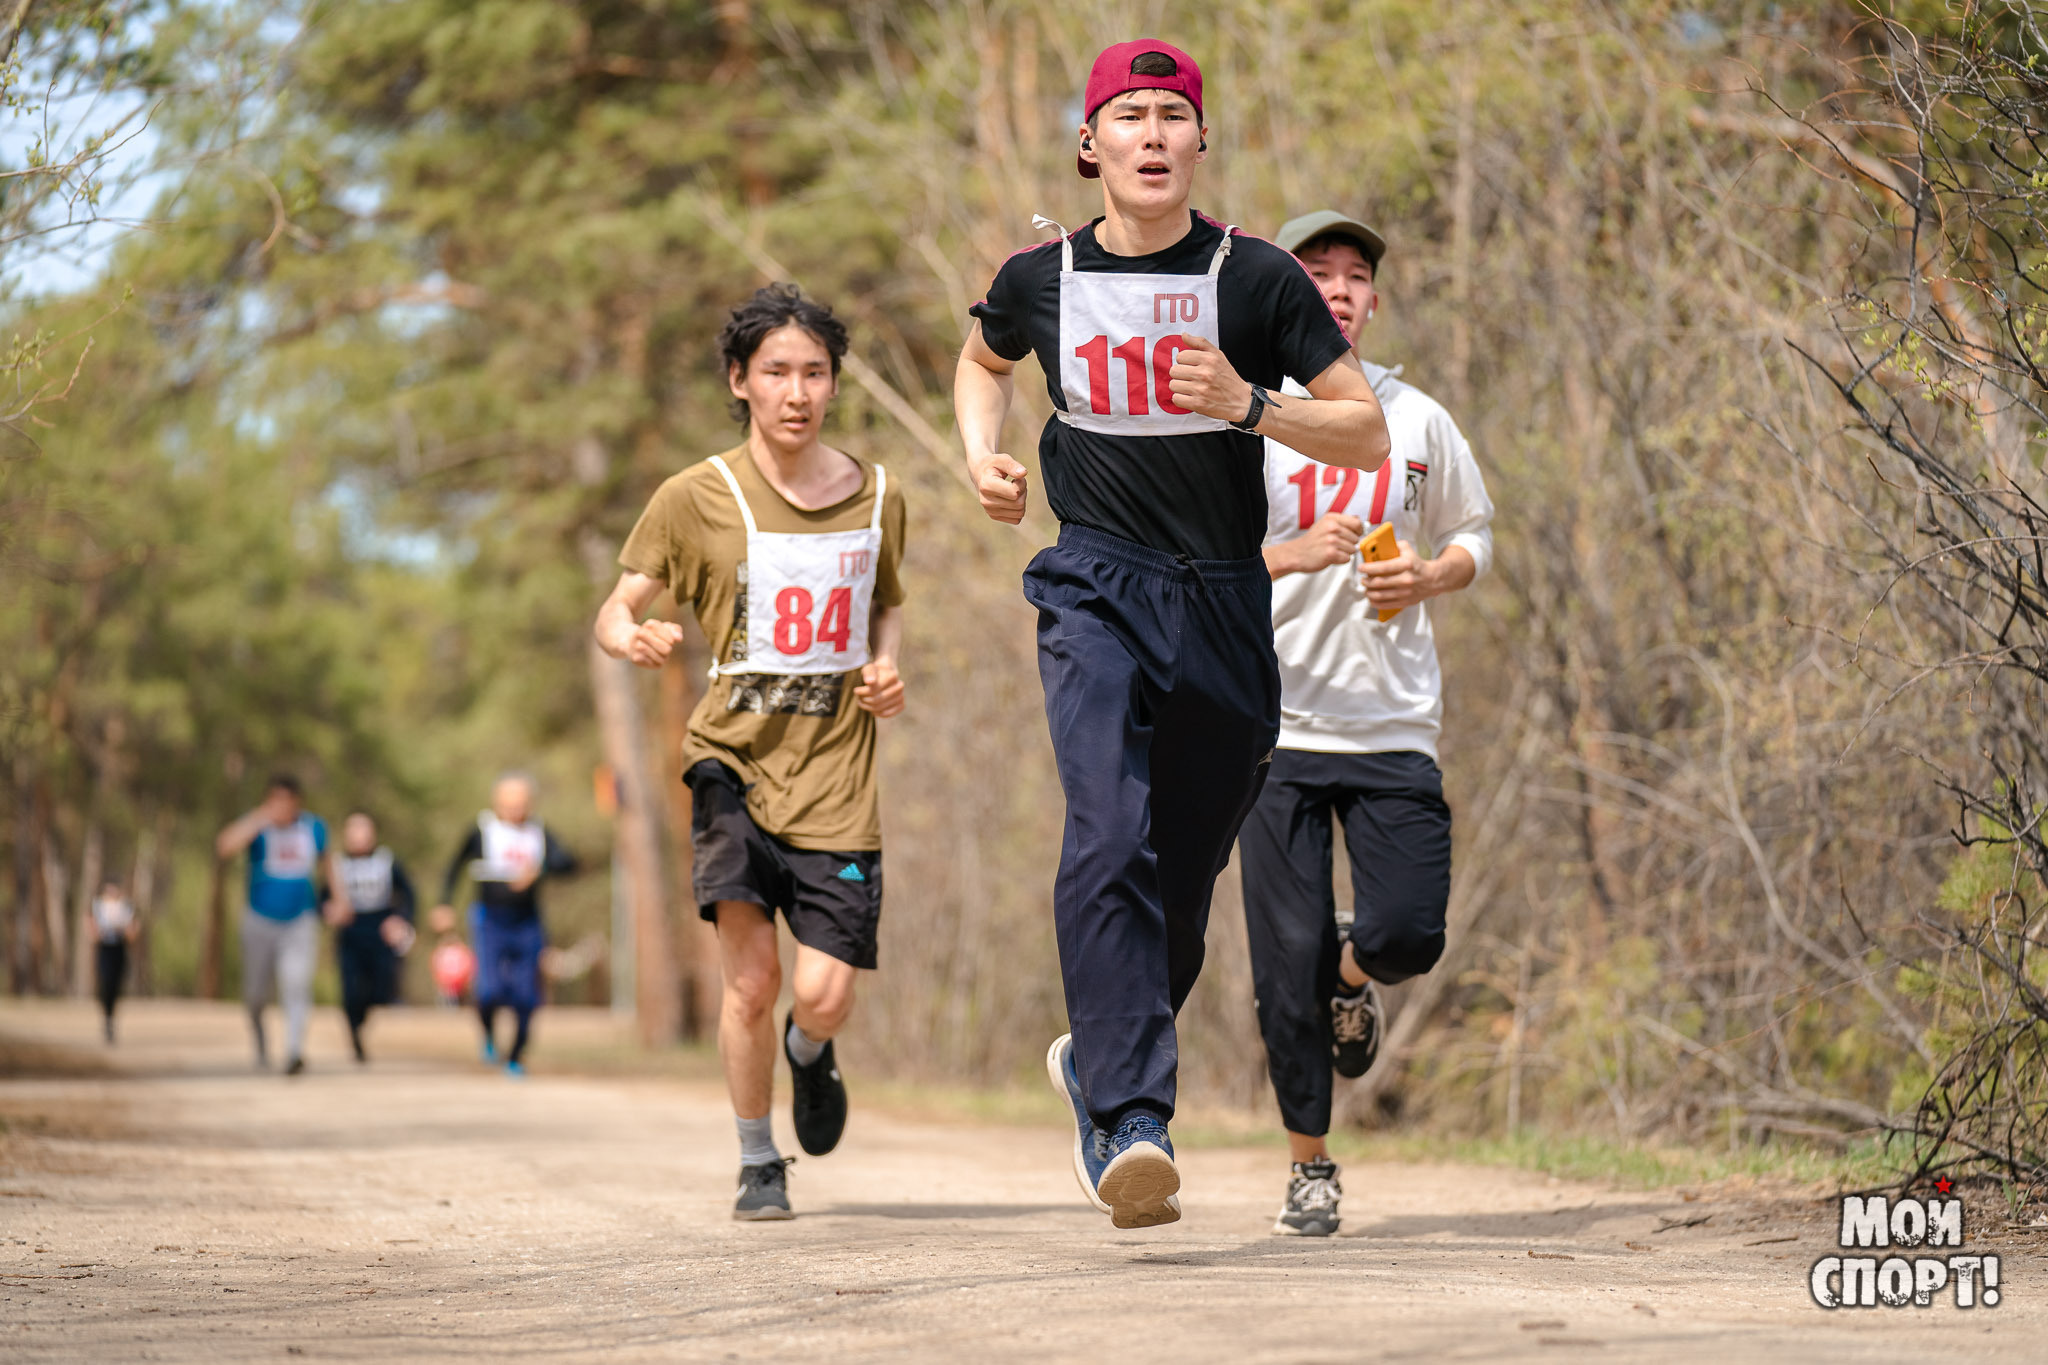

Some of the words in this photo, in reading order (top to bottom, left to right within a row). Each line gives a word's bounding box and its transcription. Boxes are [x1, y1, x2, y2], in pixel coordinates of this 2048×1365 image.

[1154, 293, 1199, 323] ГТО
[839, 549, 870, 578] ГТО
[773, 586, 852, 656] 84
